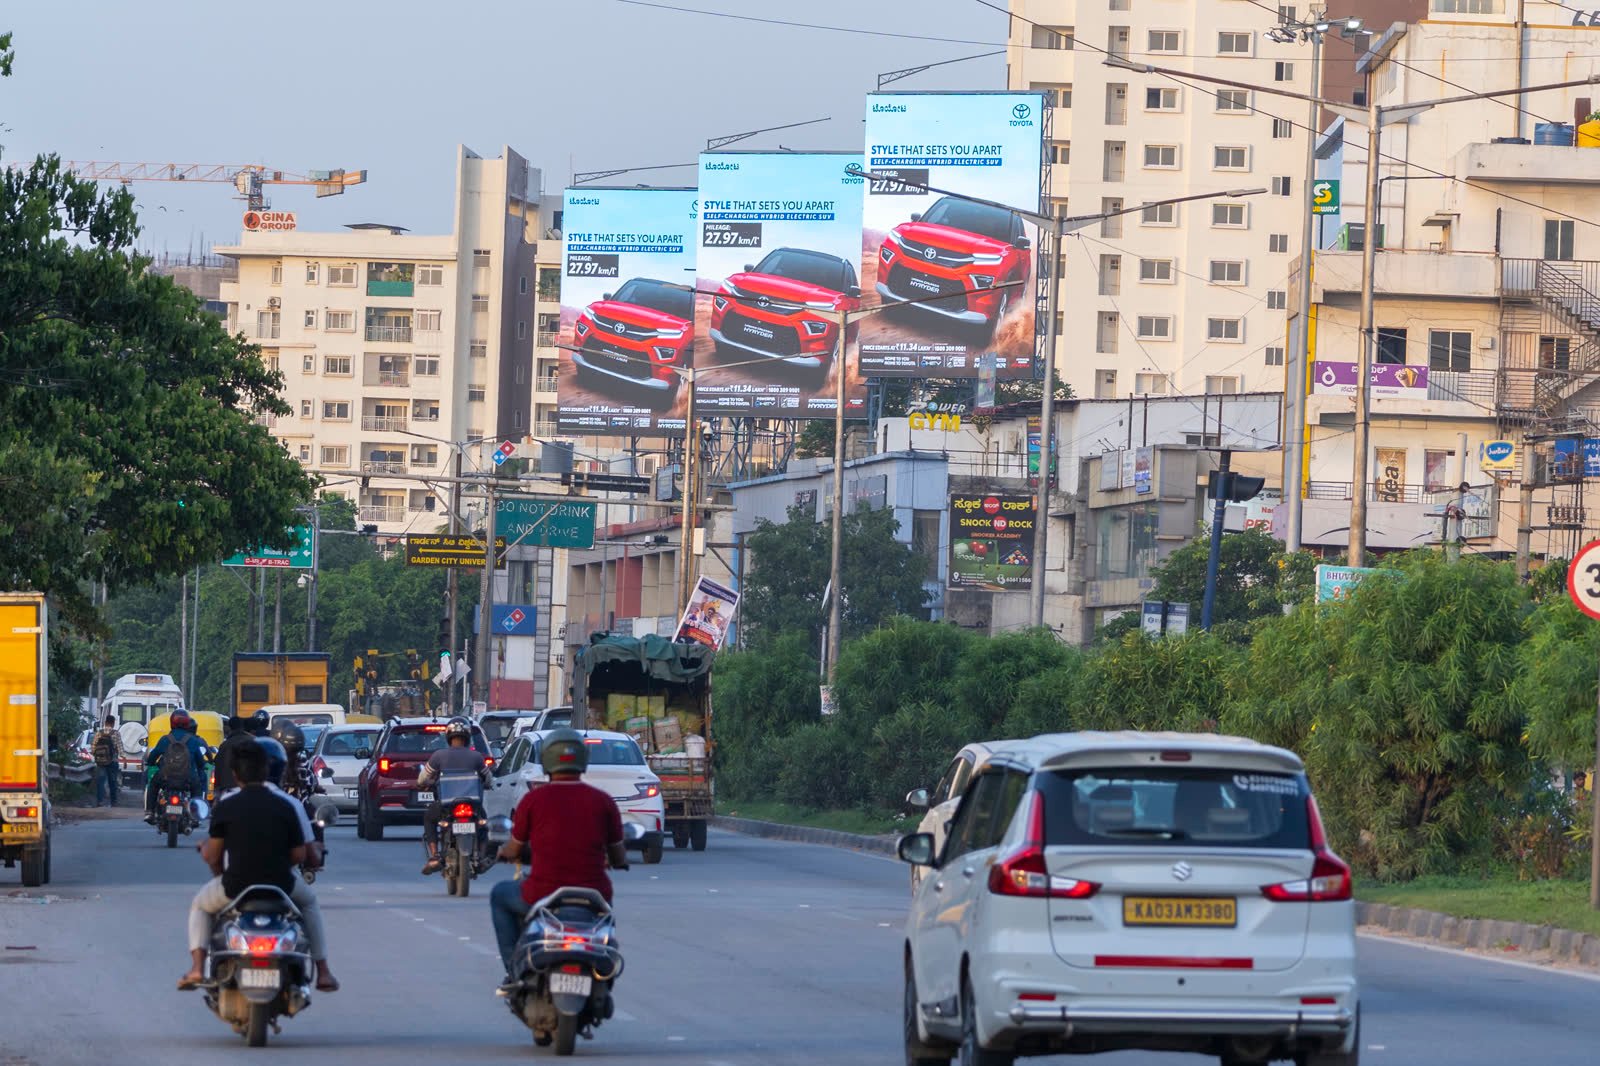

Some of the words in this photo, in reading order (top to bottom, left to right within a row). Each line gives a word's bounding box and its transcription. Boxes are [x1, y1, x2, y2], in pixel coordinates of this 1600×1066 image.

[871, 145, 898, 154] STYLE
[900, 145, 924, 154] THAT
[926, 145, 948, 155] SETS
[950, 145, 970, 155] YOU
[972, 145, 1003, 155] APART
[704, 200, 731, 210] STYLE
[733, 201, 756, 210] THAT
[758, 201, 780, 210] SETS
[782, 201, 801, 210] YOU
[805, 201, 834, 210] APART
[262, 213, 294, 222] GINA
[568, 233, 592, 242] STYLE
[594, 234, 614, 242] THAT
[616, 234, 636, 243] SETS
[637, 234, 655, 243] YOU
[658, 235, 683, 243] APART
[705, 232, 738, 244] 27.97
[568, 263, 598, 274] 27.97
[909, 412, 961, 433] GYM
[497, 500, 515, 512] DO
[519, 503, 545, 514] NOT
[550, 503, 590, 518] DRINK
[507, 523, 534, 535] AND
[540, 526, 579, 538] DRIVE
